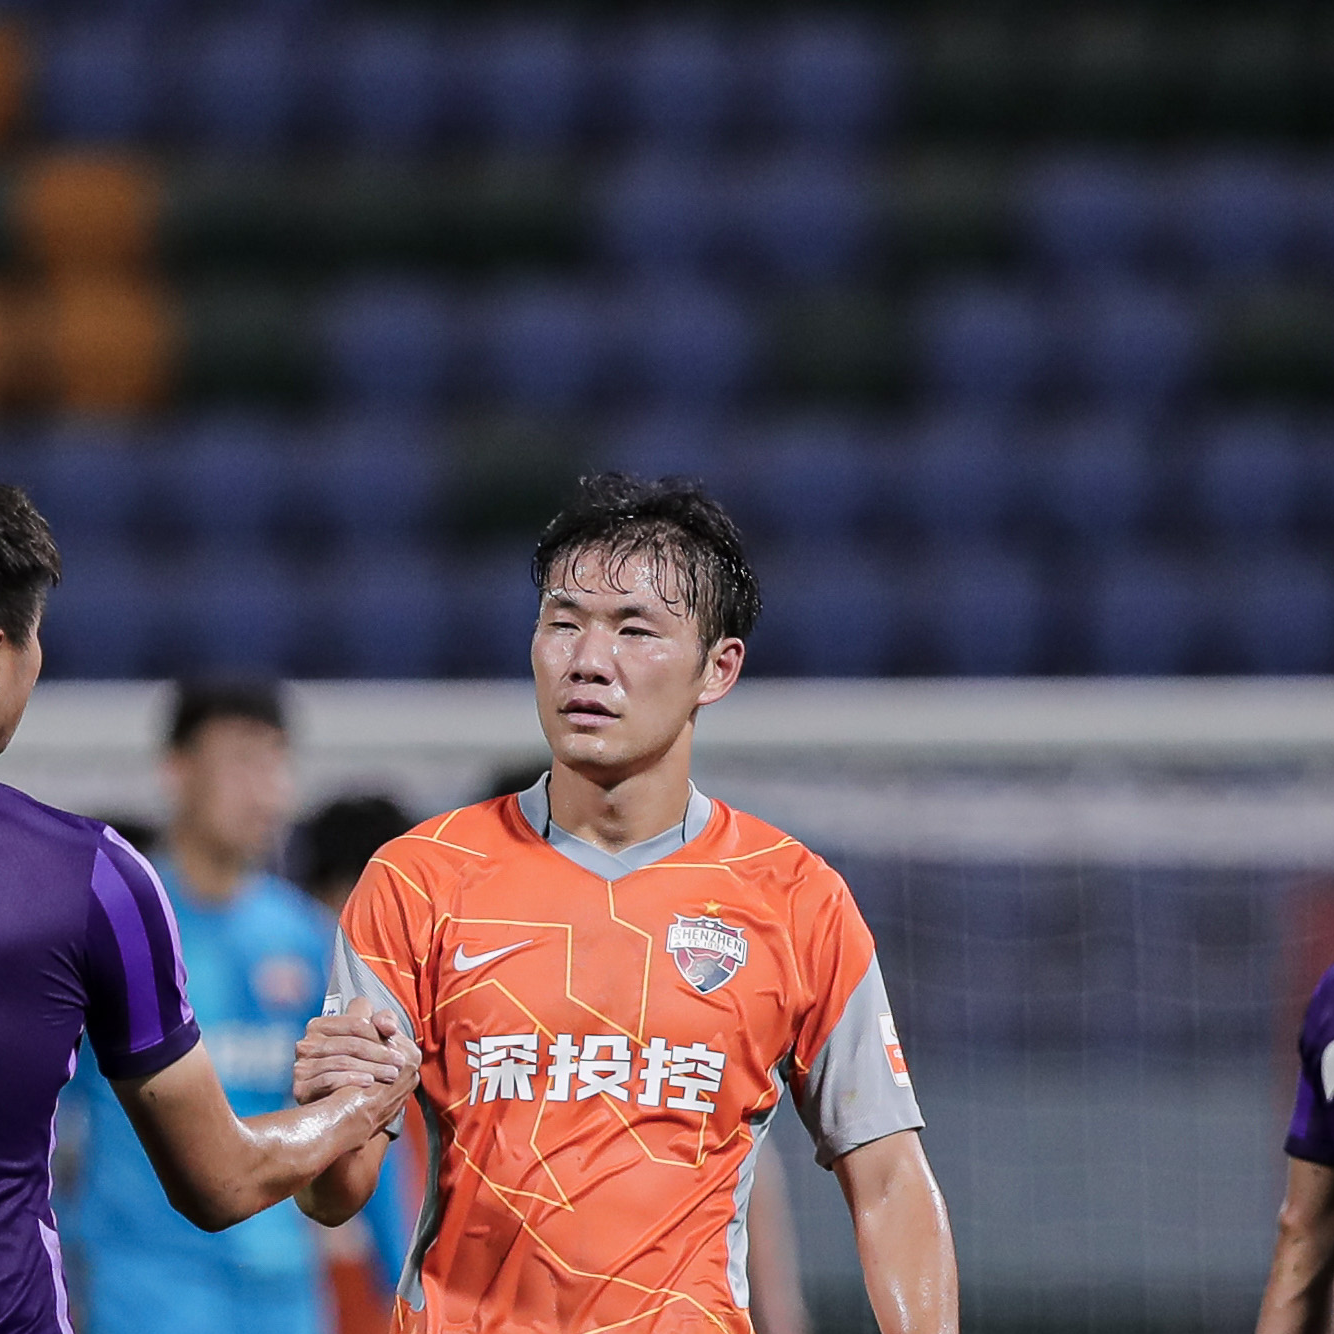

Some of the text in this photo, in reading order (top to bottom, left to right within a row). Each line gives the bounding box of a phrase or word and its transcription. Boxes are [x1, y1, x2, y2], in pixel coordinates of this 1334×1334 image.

[673, 928, 743, 954] SHENZHEN
[464, 1033, 724, 1114] 深投控
